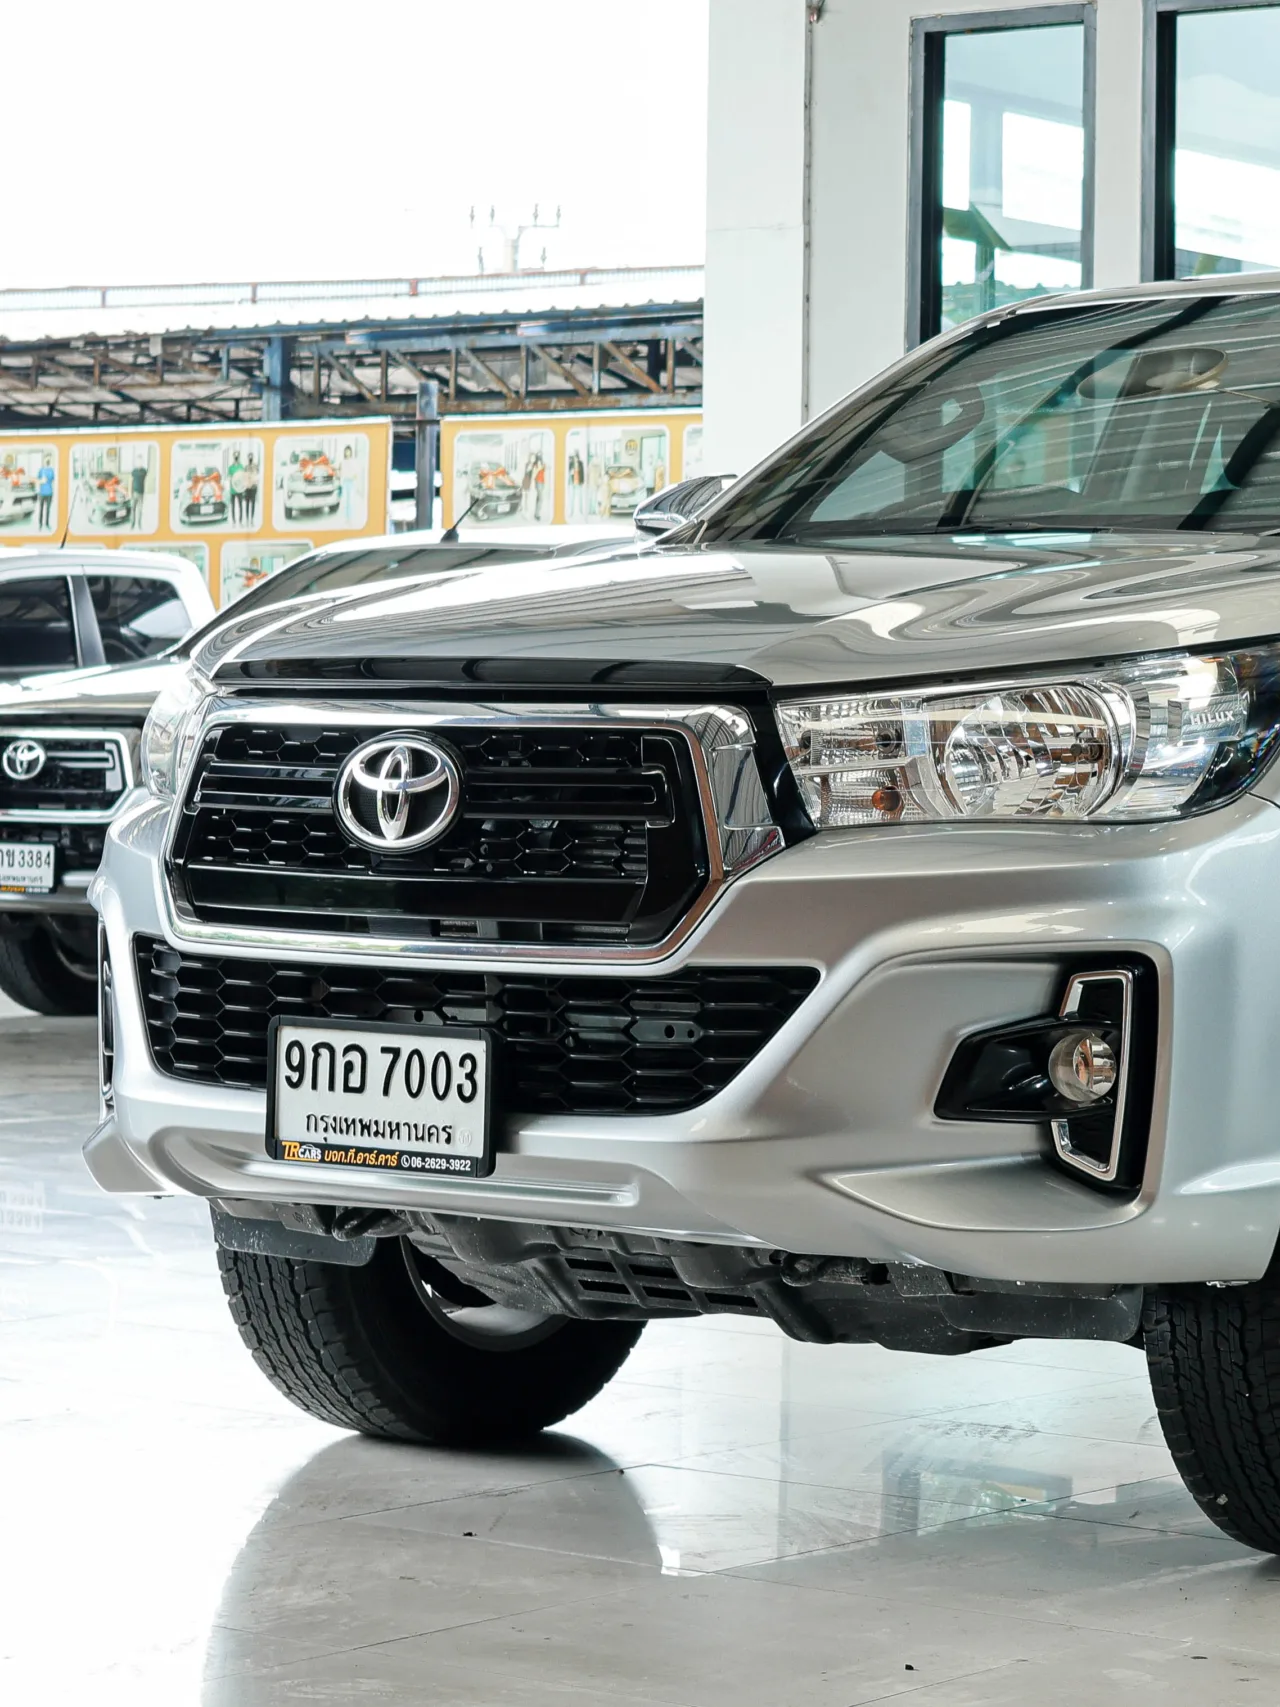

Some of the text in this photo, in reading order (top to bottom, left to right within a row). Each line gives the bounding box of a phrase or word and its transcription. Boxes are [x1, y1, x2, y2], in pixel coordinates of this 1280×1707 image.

[1190, 710, 1235, 725] HILUX
[18, 850, 51, 868] 3384
[284, 1039, 478, 1104] 9กอ 7003
[306, 1113, 453, 1145] กรุงเทพมหานคร
[411, 1156, 471, 1171] 06-2629-3922
